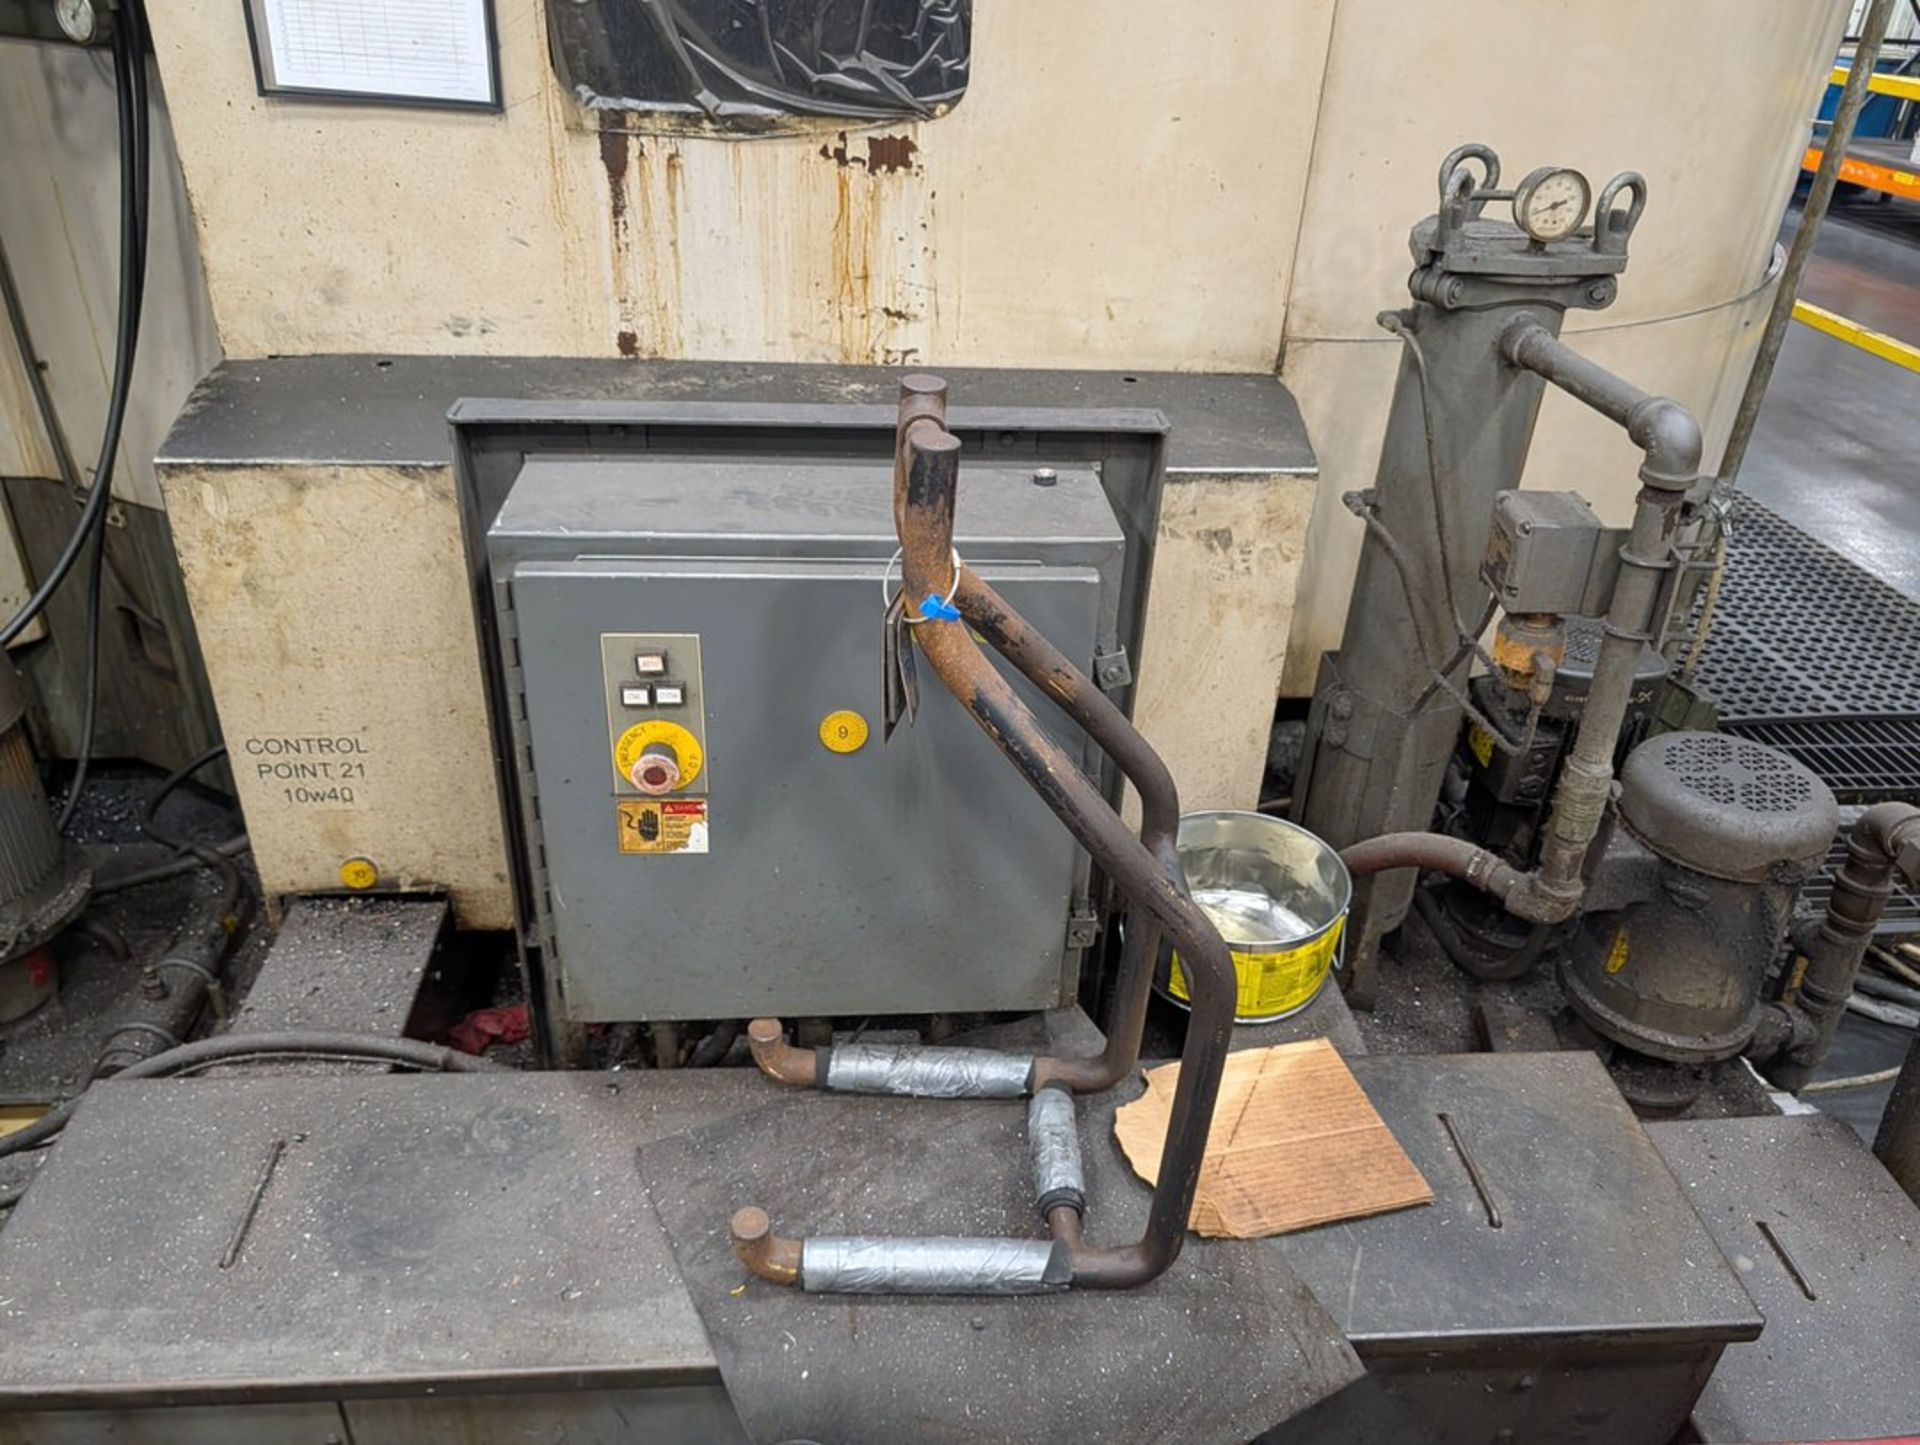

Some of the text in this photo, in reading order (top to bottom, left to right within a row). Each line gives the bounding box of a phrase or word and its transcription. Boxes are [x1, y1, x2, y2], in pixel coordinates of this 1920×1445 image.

[245, 737, 369, 755] CONTROL
[257, 762, 365, 779] POINT 21
[284, 787, 354, 803] 10w40
